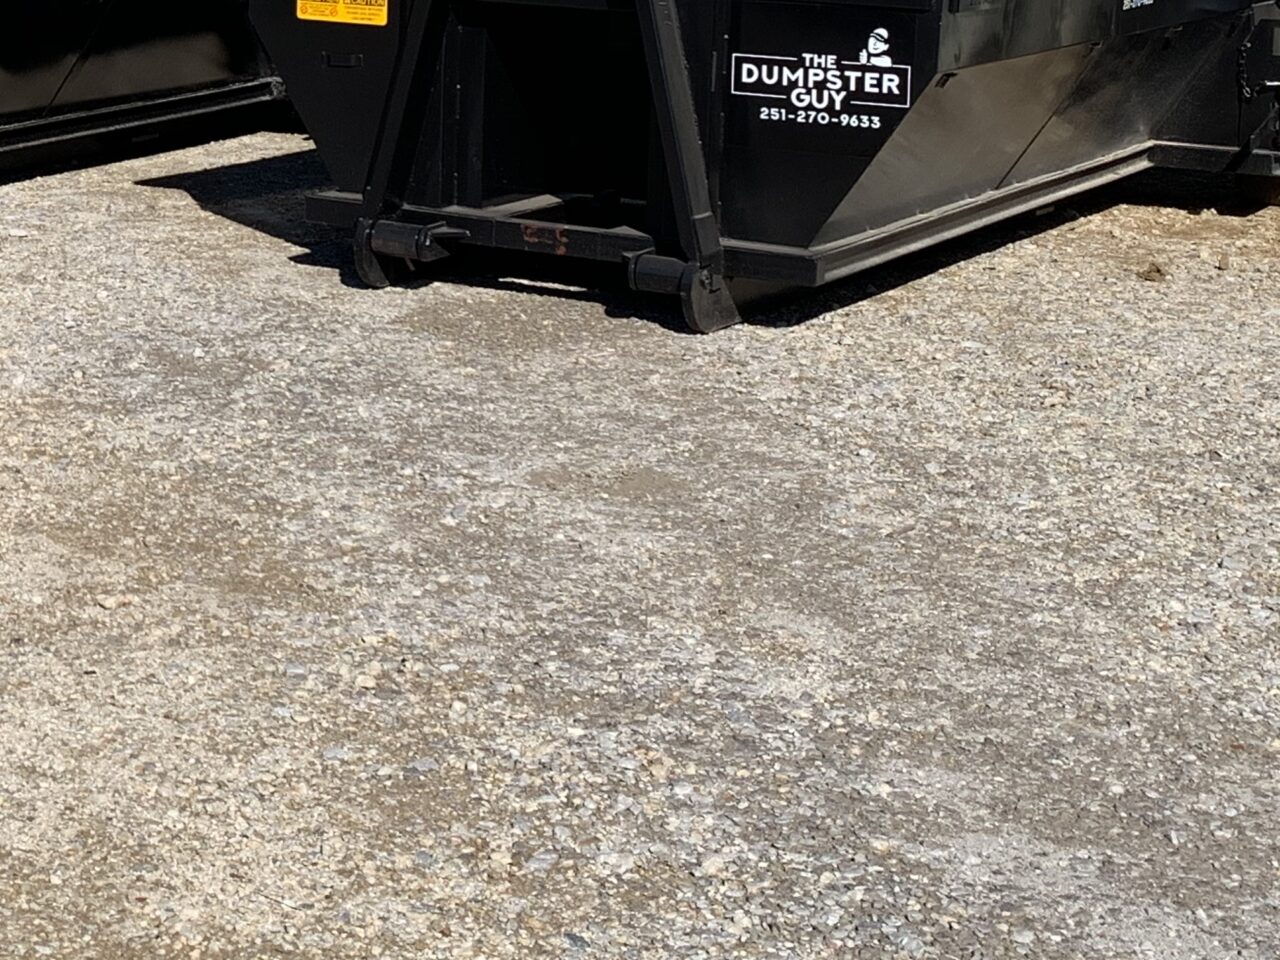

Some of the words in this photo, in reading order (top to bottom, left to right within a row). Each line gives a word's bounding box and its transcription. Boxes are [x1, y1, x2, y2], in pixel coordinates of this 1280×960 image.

[802, 53, 837, 69] THE
[741, 63, 900, 95] DUMPSTER
[790, 88, 847, 111] GUY
[759, 107, 881, 129] 251-270-9633
